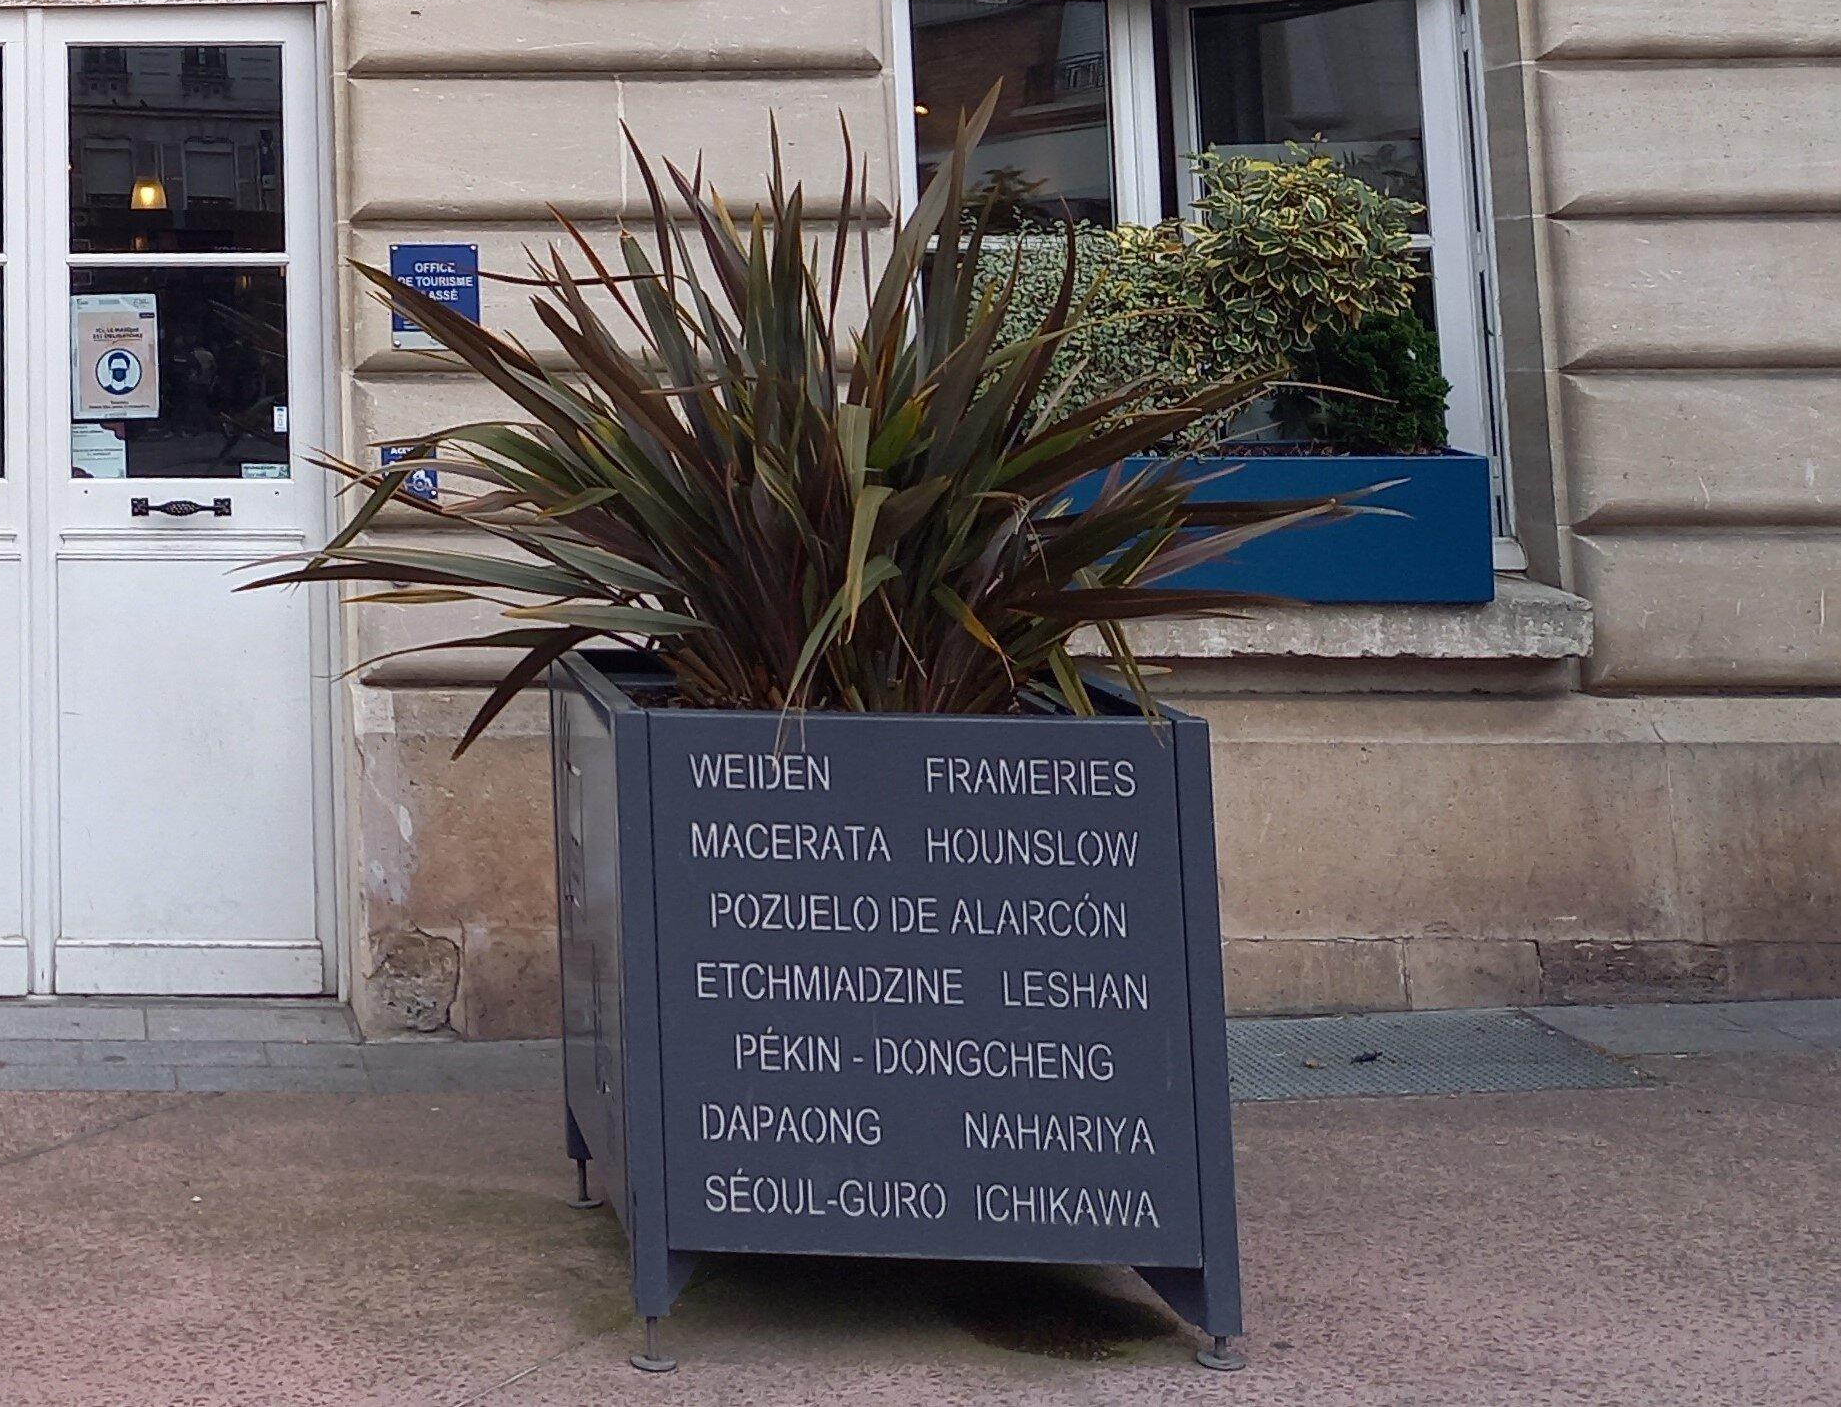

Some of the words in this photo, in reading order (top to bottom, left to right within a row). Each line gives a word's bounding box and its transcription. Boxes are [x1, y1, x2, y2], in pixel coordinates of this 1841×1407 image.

[415, 263, 455, 273] OFFICE
[415, 277, 473, 286] TOURISME
[689, 754, 830, 790] WEIDEN
[927, 758, 1135, 796] FRAMERIES
[692, 823, 890, 861] MACERATA
[927, 828, 1137, 866] HOUNSLOW
[711, 893, 878, 931] POZUELO
[892, 898, 939, 933] DE
[951, 893, 1126, 937] ALARCÓN
[697, 963, 963, 1004] ETCHMIADZINE
[1004, 971, 1147, 1009] LESHAN
[736, 1027, 840, 1072] PÉKIN
[876, 1039, 1113, 1080] DONGCHENG
[703, 1104, 880, 1145] DAPAONG
[966, 1112, 1154, 1154] NAHARIYA
[706, 1168, 945, 1218] SÉOUL-GURO
[977, 1185, 1160, 1228] ICHIKAWA
